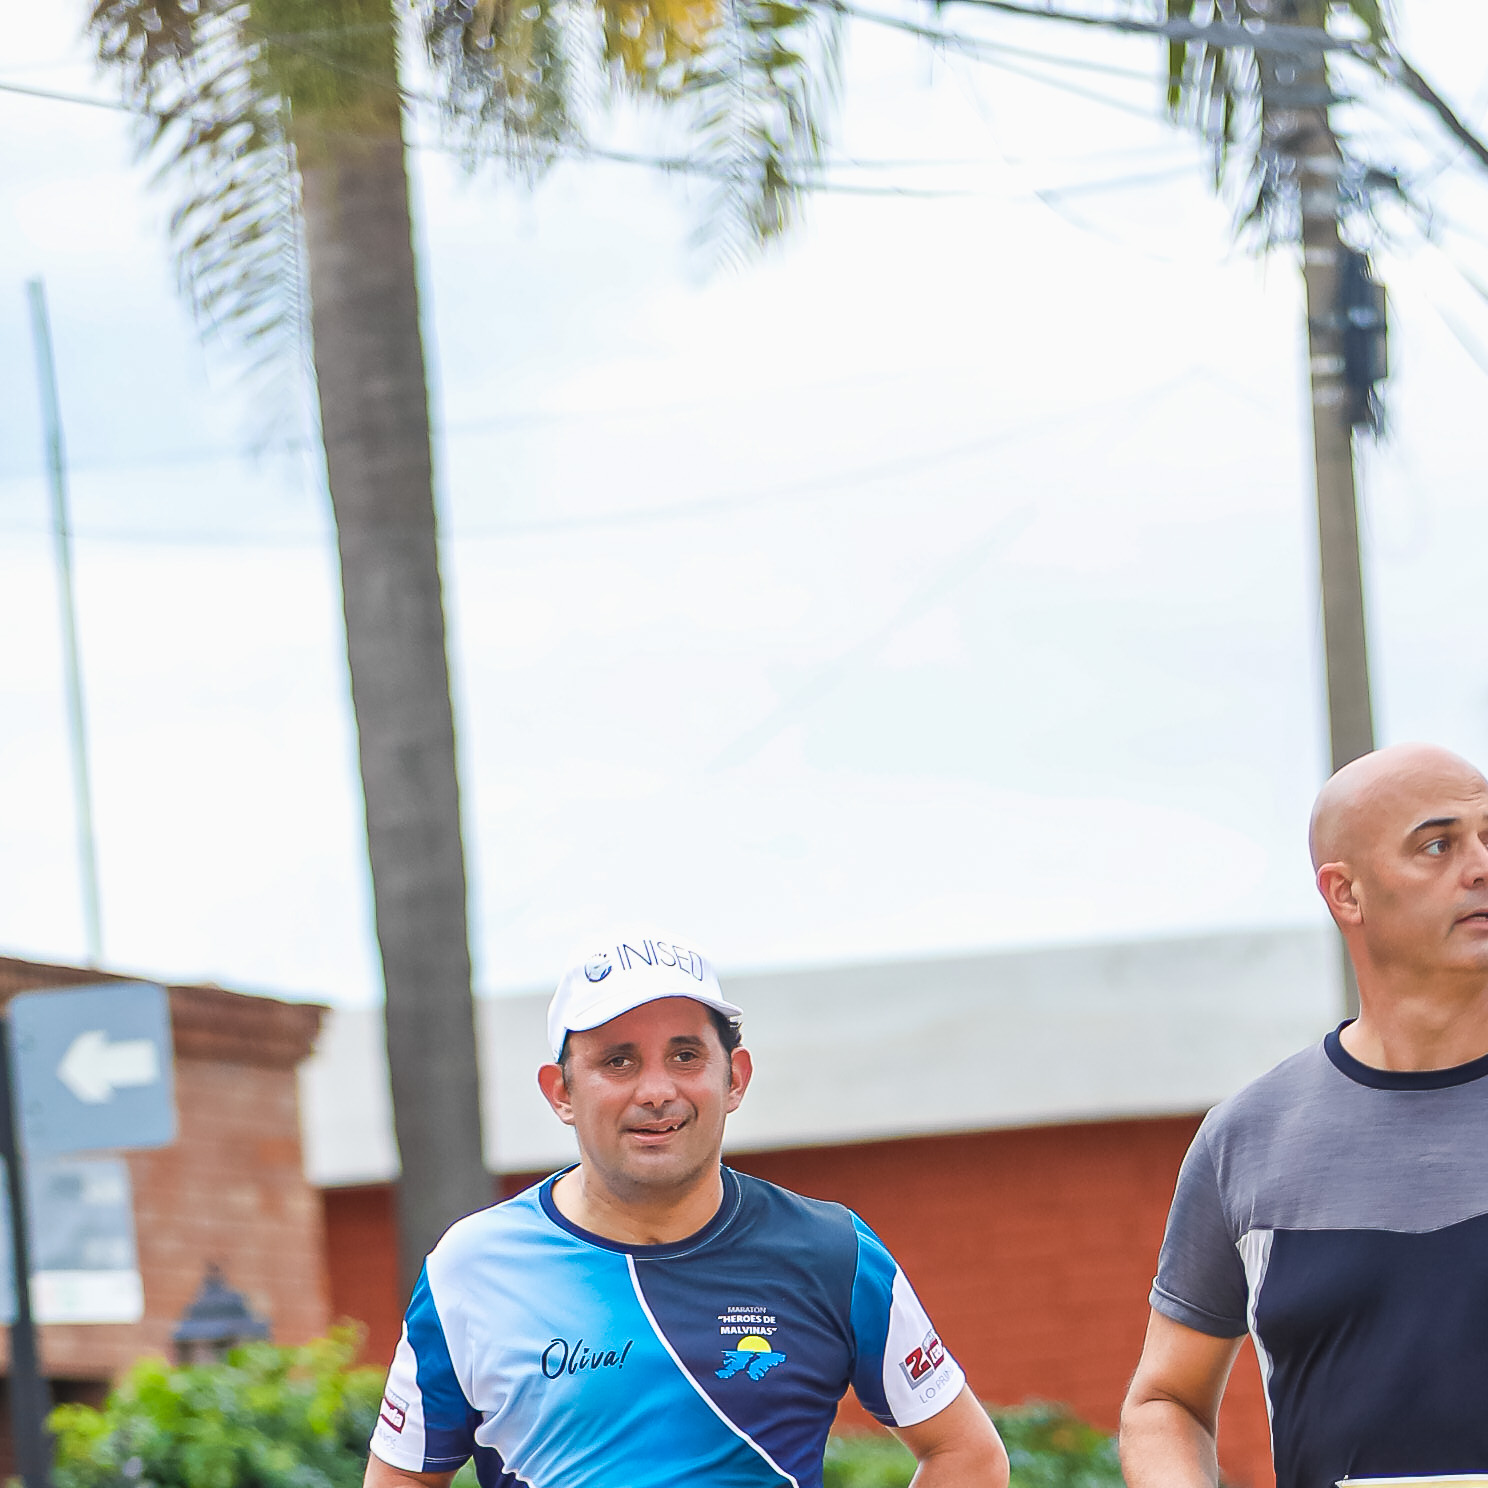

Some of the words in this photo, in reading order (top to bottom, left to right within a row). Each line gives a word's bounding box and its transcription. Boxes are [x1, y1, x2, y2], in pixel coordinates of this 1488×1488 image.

[616, 939, 703, 981] INISED
[762, 1315, 777, 1324] DE
[541, 1337, 634, 1380] Oliva!
